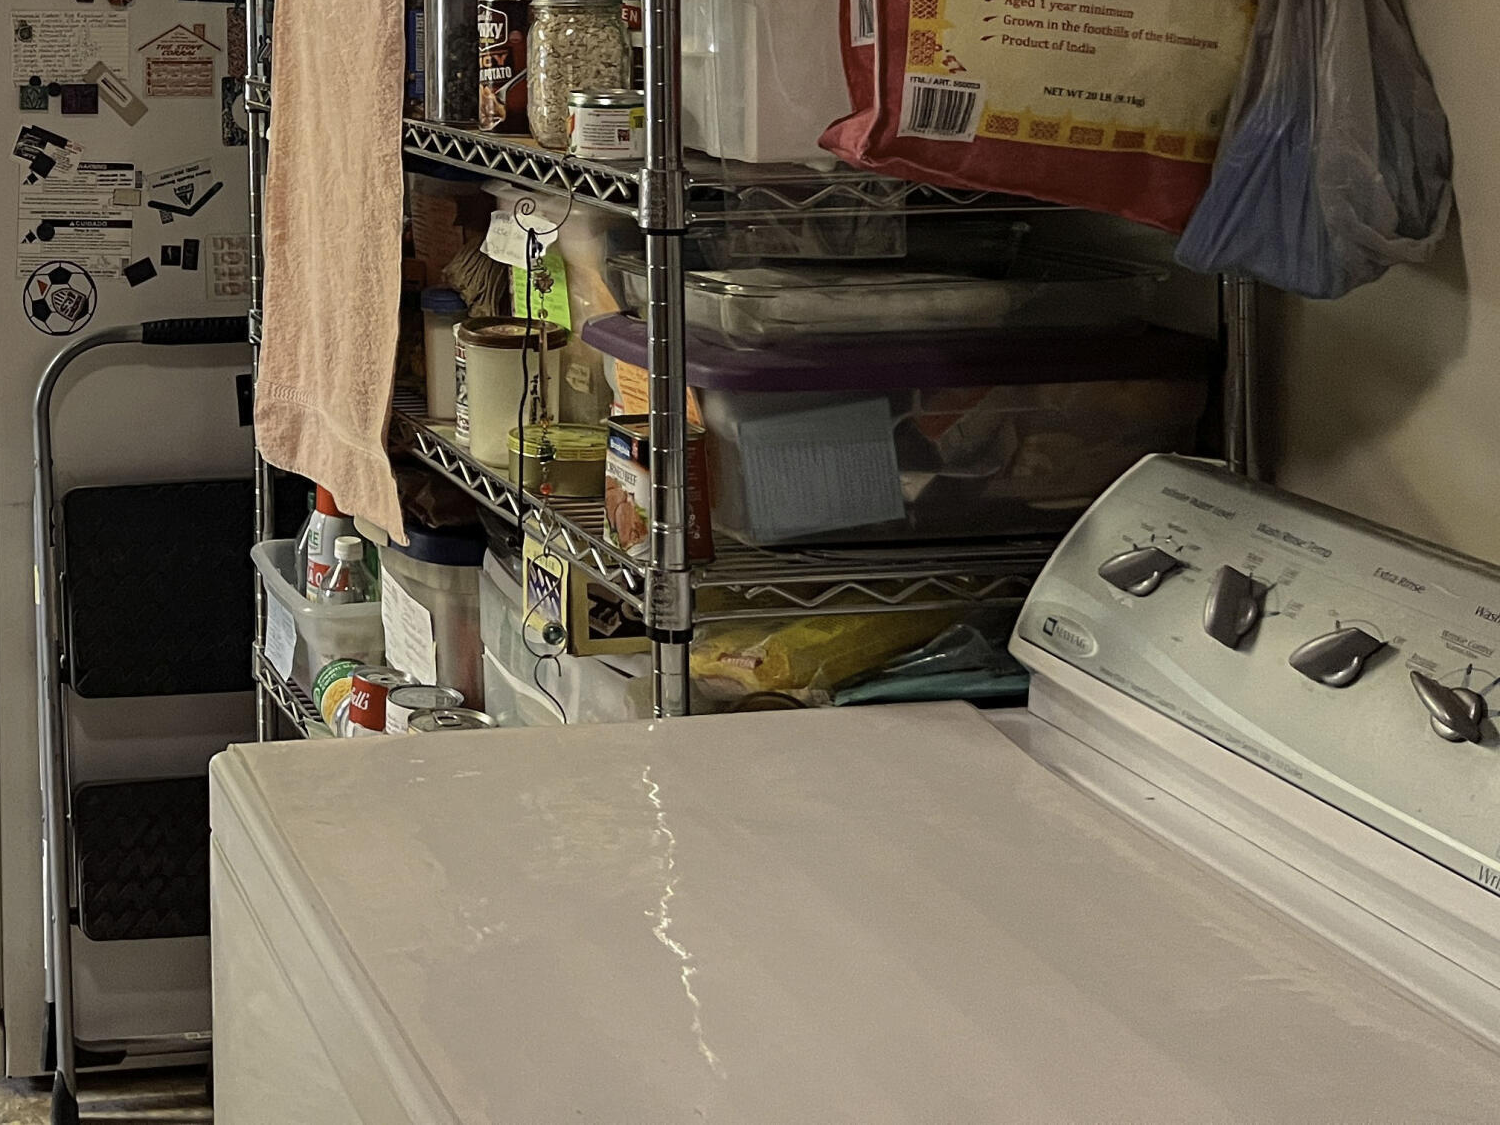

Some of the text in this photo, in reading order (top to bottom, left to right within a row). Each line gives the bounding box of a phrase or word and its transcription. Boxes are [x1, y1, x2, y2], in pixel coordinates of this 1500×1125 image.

[1048, 1, 1077, 12] year
[1079, 3, 1134, 18] minimum
[1003, 15, 1044, 29] Grown
[1047, 18, 1058, 30] in
[1061, 20, 1081, 32] the
[1131, 29, 1145, 40] of
[1145, 31, 1163, 42] the
[1001, 34, 1097, 54] Product of India
[1043, 86, 1064, 98] NET
[1066, 88, 1084, 99] WT
